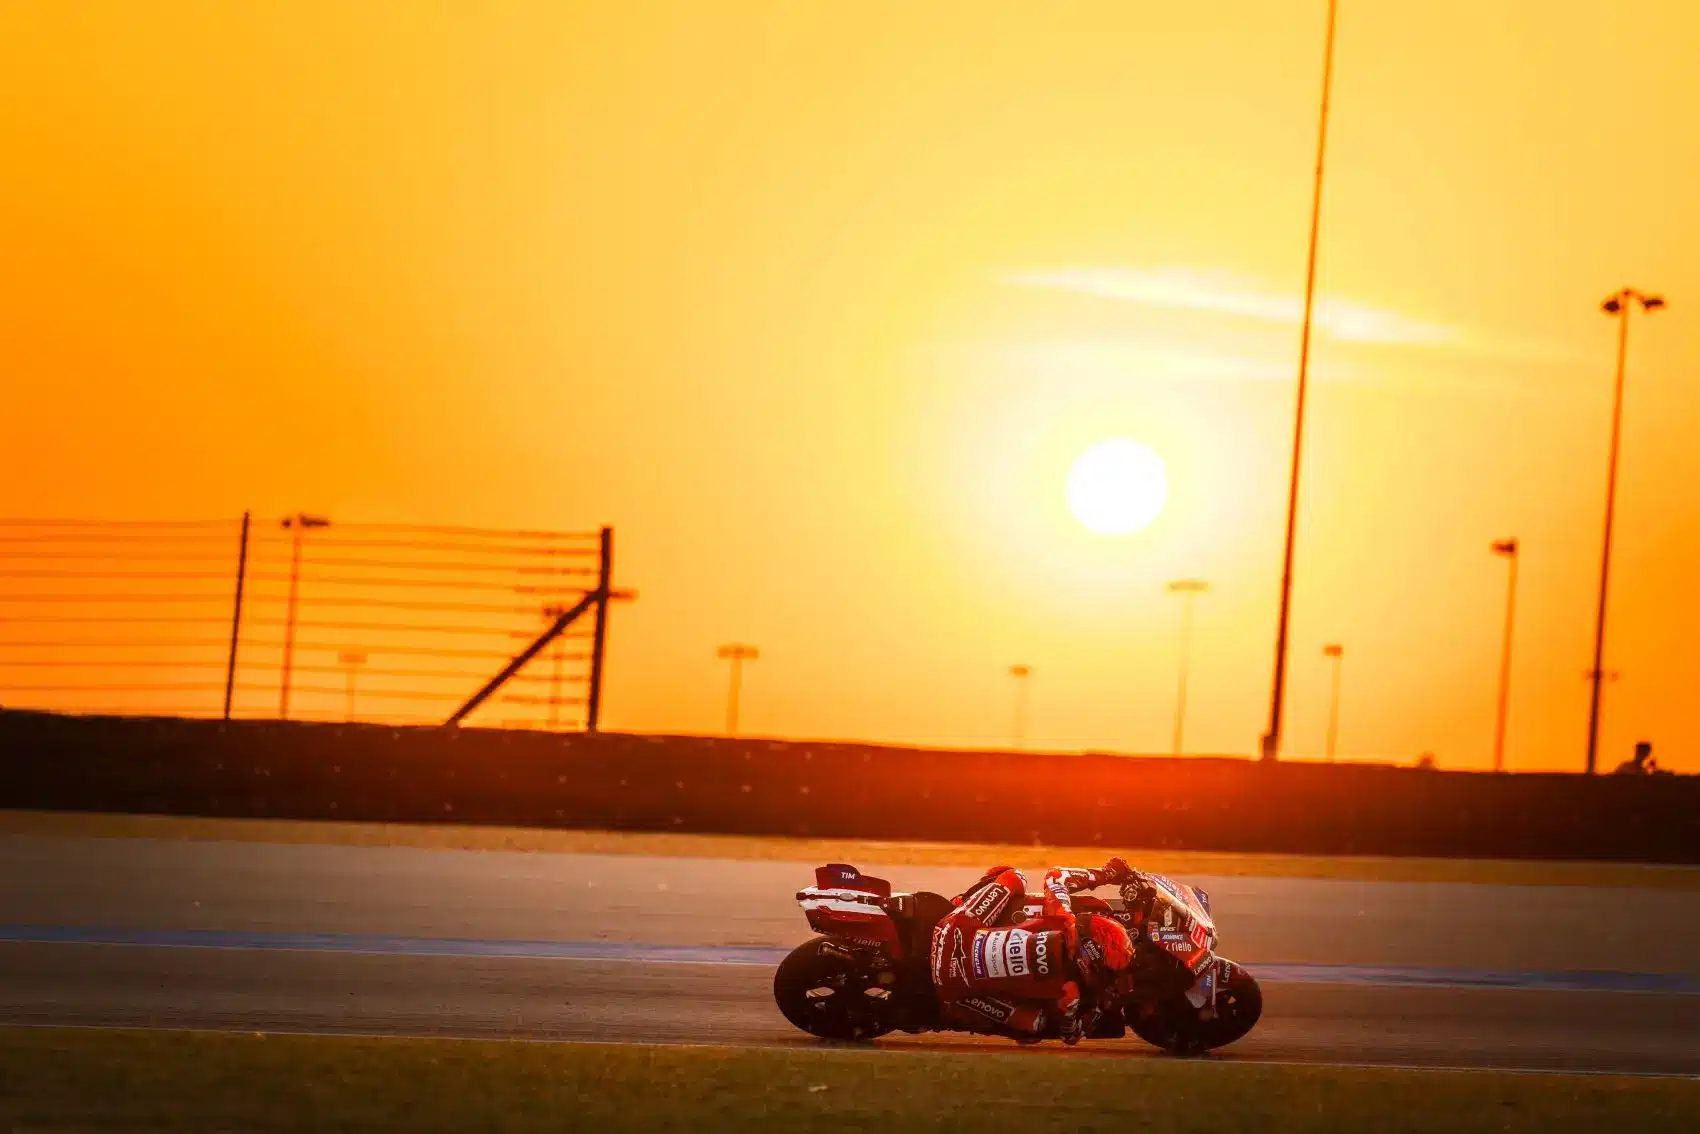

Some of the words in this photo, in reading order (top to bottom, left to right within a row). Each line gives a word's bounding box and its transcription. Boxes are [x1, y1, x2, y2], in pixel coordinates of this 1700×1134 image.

[841, 871, 856, 880] TIM
[975, 887, 1004, 915] Lenovo
[1035, 931, 1049, 975] enovo
[1171, 941, 1192, 952] riello
[1194, 956, 1212, 976] Lenovo
[1221, 961, 1231, 983] Leno
